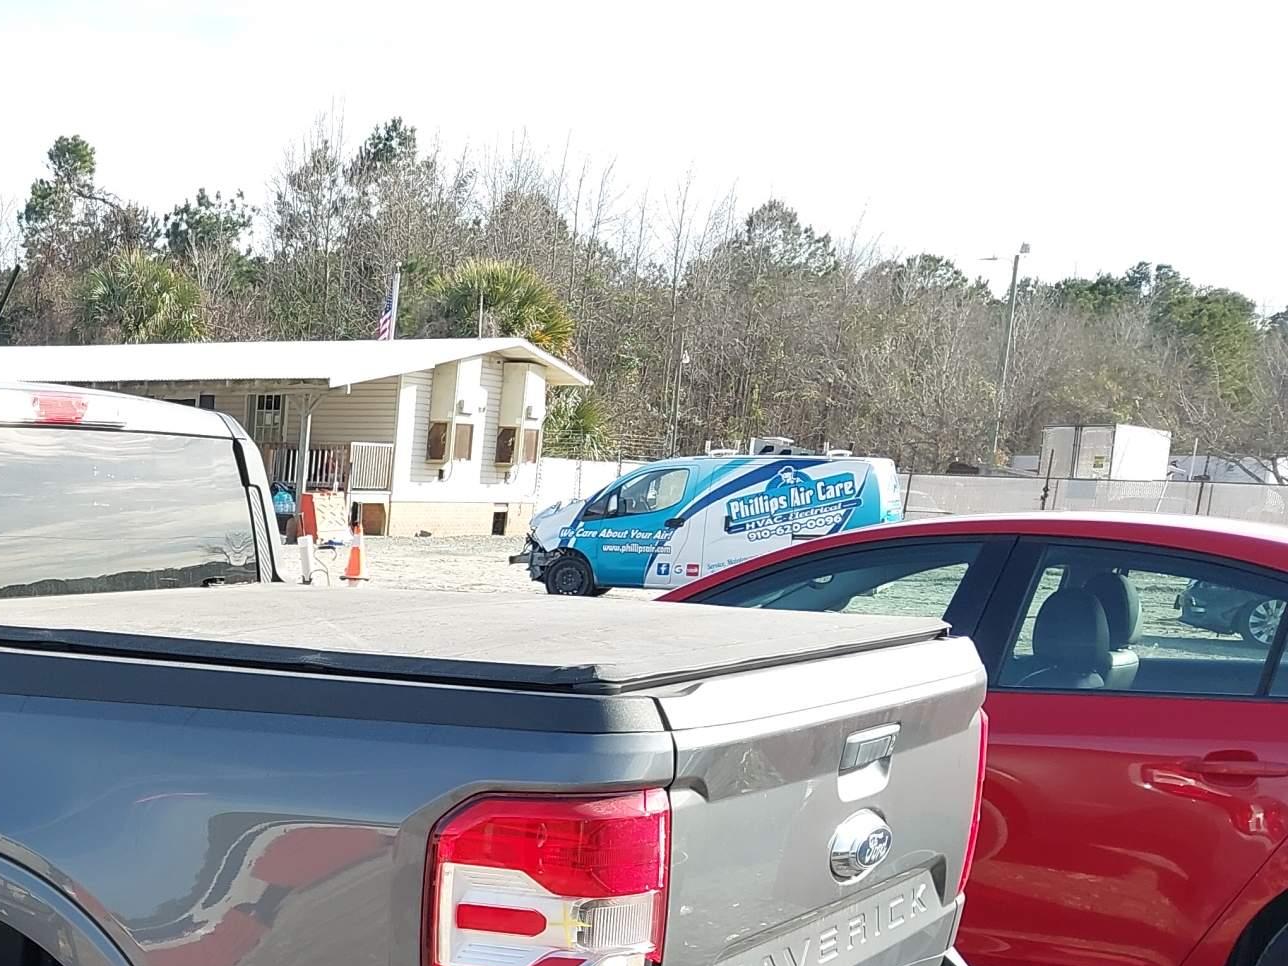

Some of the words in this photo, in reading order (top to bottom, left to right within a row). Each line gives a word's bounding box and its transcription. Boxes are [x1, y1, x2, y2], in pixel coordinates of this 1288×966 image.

[729, 494, 788, 521] Phillips
[790, 486, 814, 508] Air
[816, 480, 854, 501] Care
[560, 528, 575, 538] We
[576, 528, 598, 538] Care
[598, 528, 628, 539] About
[630, 529, 652, 539] Your
[654, 530, 673, 540] Air!
[747, 514, 843, 542] 910-620-0096
[602, 543, 672, 554] www.phillipsair.com
[864, 831, 889, 865] Ford
